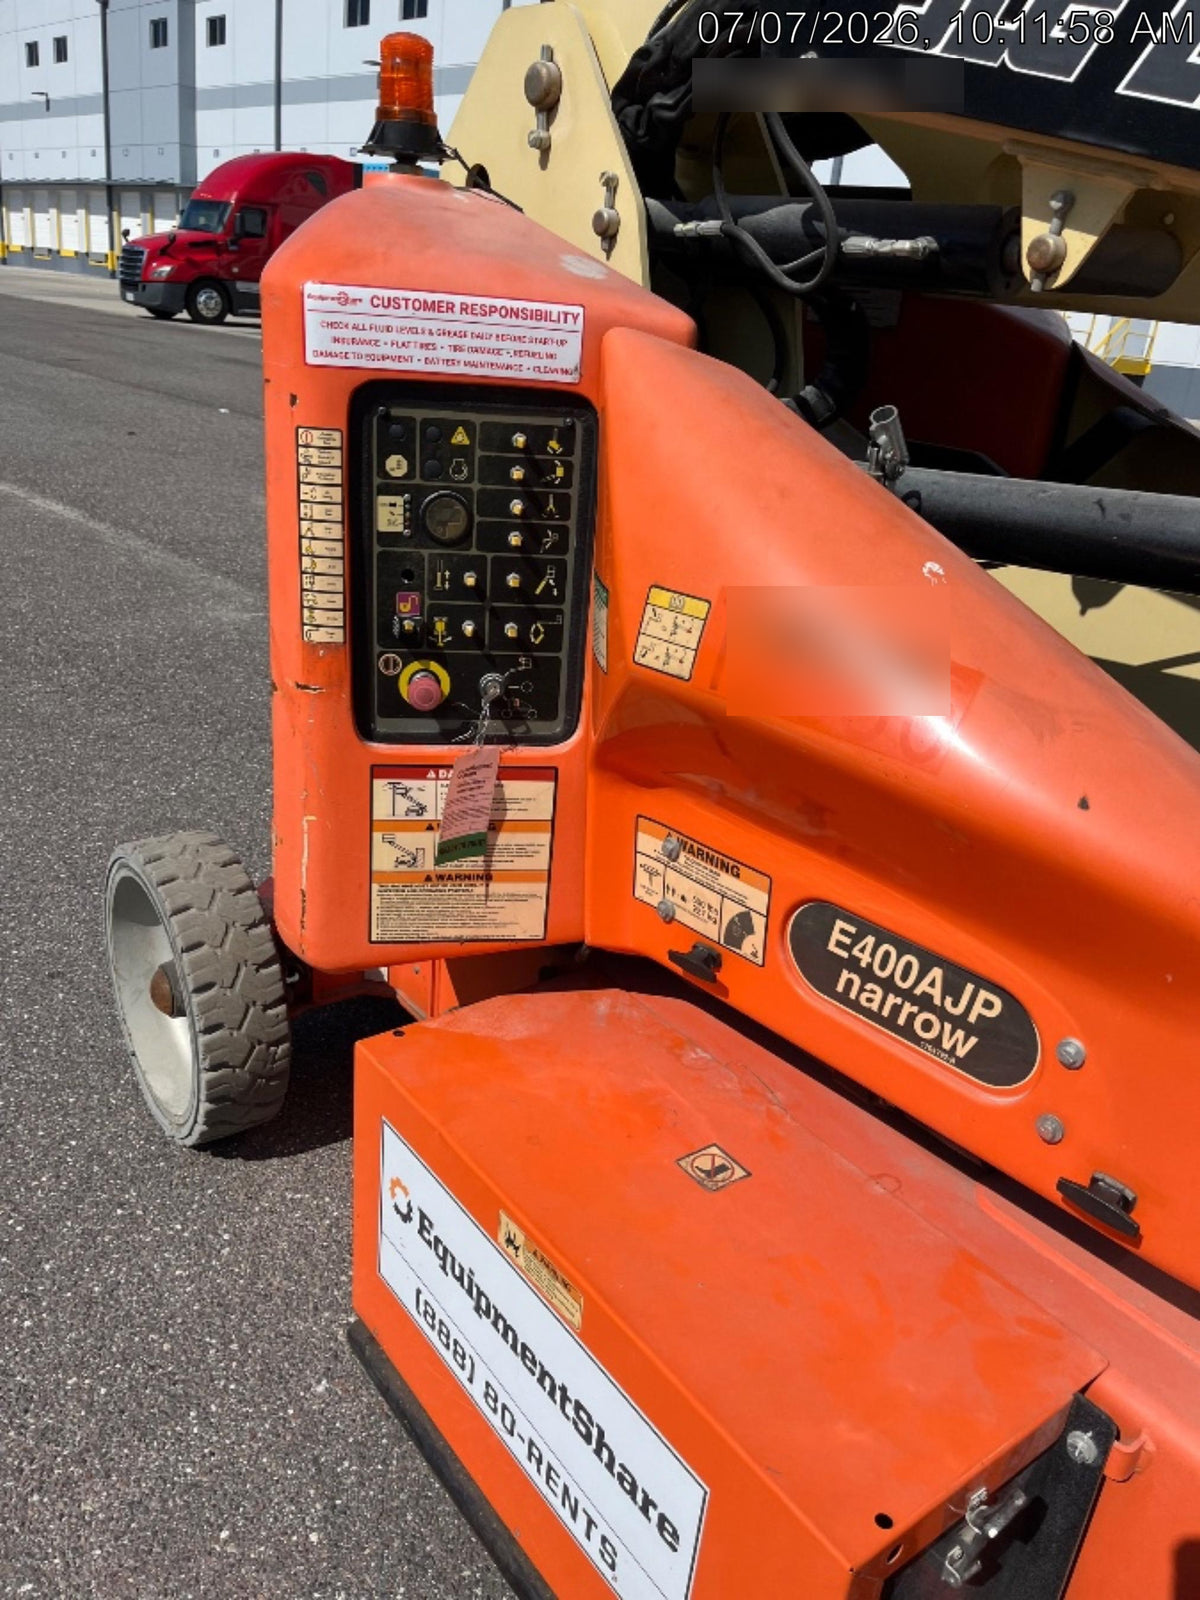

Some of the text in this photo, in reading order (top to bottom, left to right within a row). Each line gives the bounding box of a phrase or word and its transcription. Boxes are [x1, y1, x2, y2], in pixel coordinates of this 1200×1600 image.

[369, 294, 456, 314] CUSTOMER
[459, 301, 581, 325] RESPONSIBILITY
[320, 320, 349, 330] CHECK
[351, 322, 368, 332] ALL
[369, 323, 394, 333] FLUID
[470, 331, 493, 341] DAILY
[331, 336, 382, 347] INSURANCE
[390, 340, 412, 350] FLAT
[467, 346, 504, 356] DAMAGE
[312, 350, 350, 360] DAMAGE
[351, 351, 363, 360] TO
[364, 352, 415, 363] EQUIPMENT
[424, 356, 460, 367] BATTERY
[463, 360, 524, 372] MAINTENANCE
[676, 836, 741, 879] WARNING
[435, 873, 493, 882] WARNING
[827, 918, 1003, 1025] E400AJP
[834, 968, 979, 1059] narrow
[416, 1206, 680, 1553] EquipmentShare
[415, 1286, 476, 1385] (888)
[483, 1379, 618, 1573] 80-RENTS
